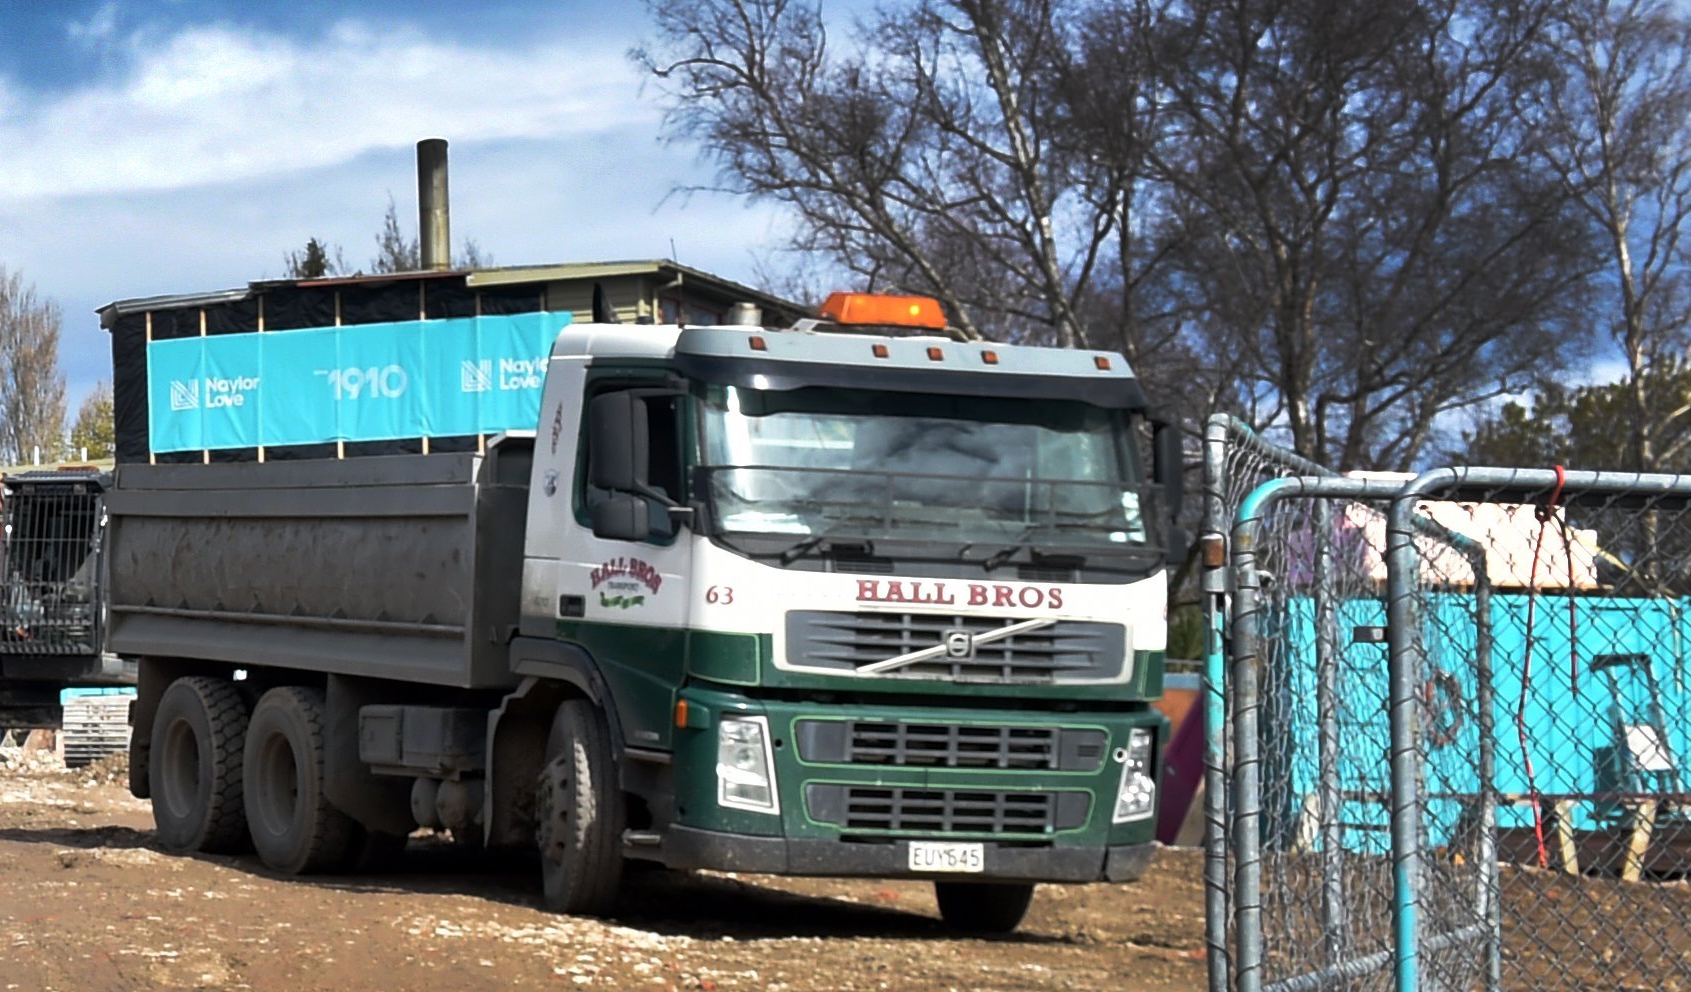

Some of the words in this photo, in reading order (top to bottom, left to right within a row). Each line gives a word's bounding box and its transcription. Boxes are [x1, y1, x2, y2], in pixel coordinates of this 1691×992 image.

[499, 357, 549, 375] Naylo
[205, 376, 260, 394] Naylor
[328, 364, 407, 400] 1910
[499, 375, 541, 390] Love
[205, 391, 244, 408] Love
[590, 556, 626, 590] HALL
[629, 557, 662, 595] BROS
[705, 585, 734, 605] 63
[856, 580, 955, 605] HALL
[967, 584, 1064, 610] BROS
